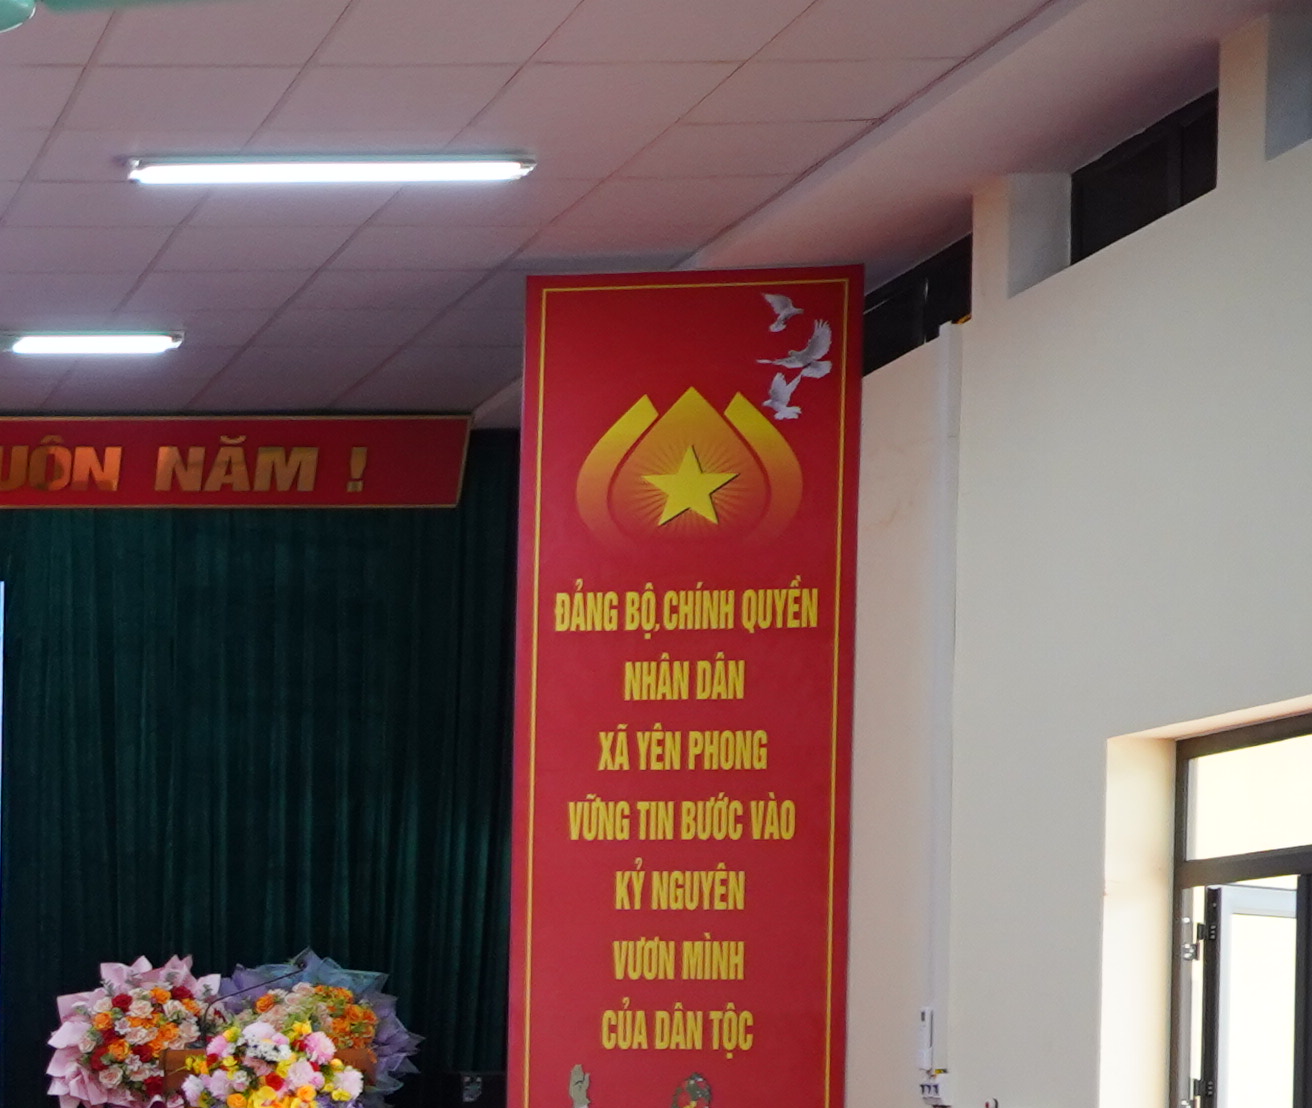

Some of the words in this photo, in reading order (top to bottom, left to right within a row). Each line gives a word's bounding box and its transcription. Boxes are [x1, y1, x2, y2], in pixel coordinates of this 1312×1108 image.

[154, 434, 319, 492] NĂM
[346, 446, 368, 492] !
[554, 579, 618, 631] ĐẢNG
[663, 581, 735, 630] CHÍNH
[741, 575, 818, 634] QUYỀN
[624, 652, 689, 701] NHÂN
[696, 651, 745, 700] DÂN
[597, 723, 630, 771] XÃ
[636, 722, 681, 771] YÊN
[688, 730, 768, 770] PHONG
[568, 793, 630, 841] VỮNG
[636, 801, 675, 841] TIN
[680, 792, 743, 840] BƯỚC
[750, 791, 796, 840] VÀO
[615, 857, 645, 911] KỶ
[651, 862, 745, 911] NGUYÊN
[613, 936, 675, 980] VƯƠN
[681, 932, 745, 980] MÌNH
[601, 997, 648, 1050] CỦA
[655, 1002, 703, 1050] DÂN
[709, 1002, 754, 1059] TỘC
